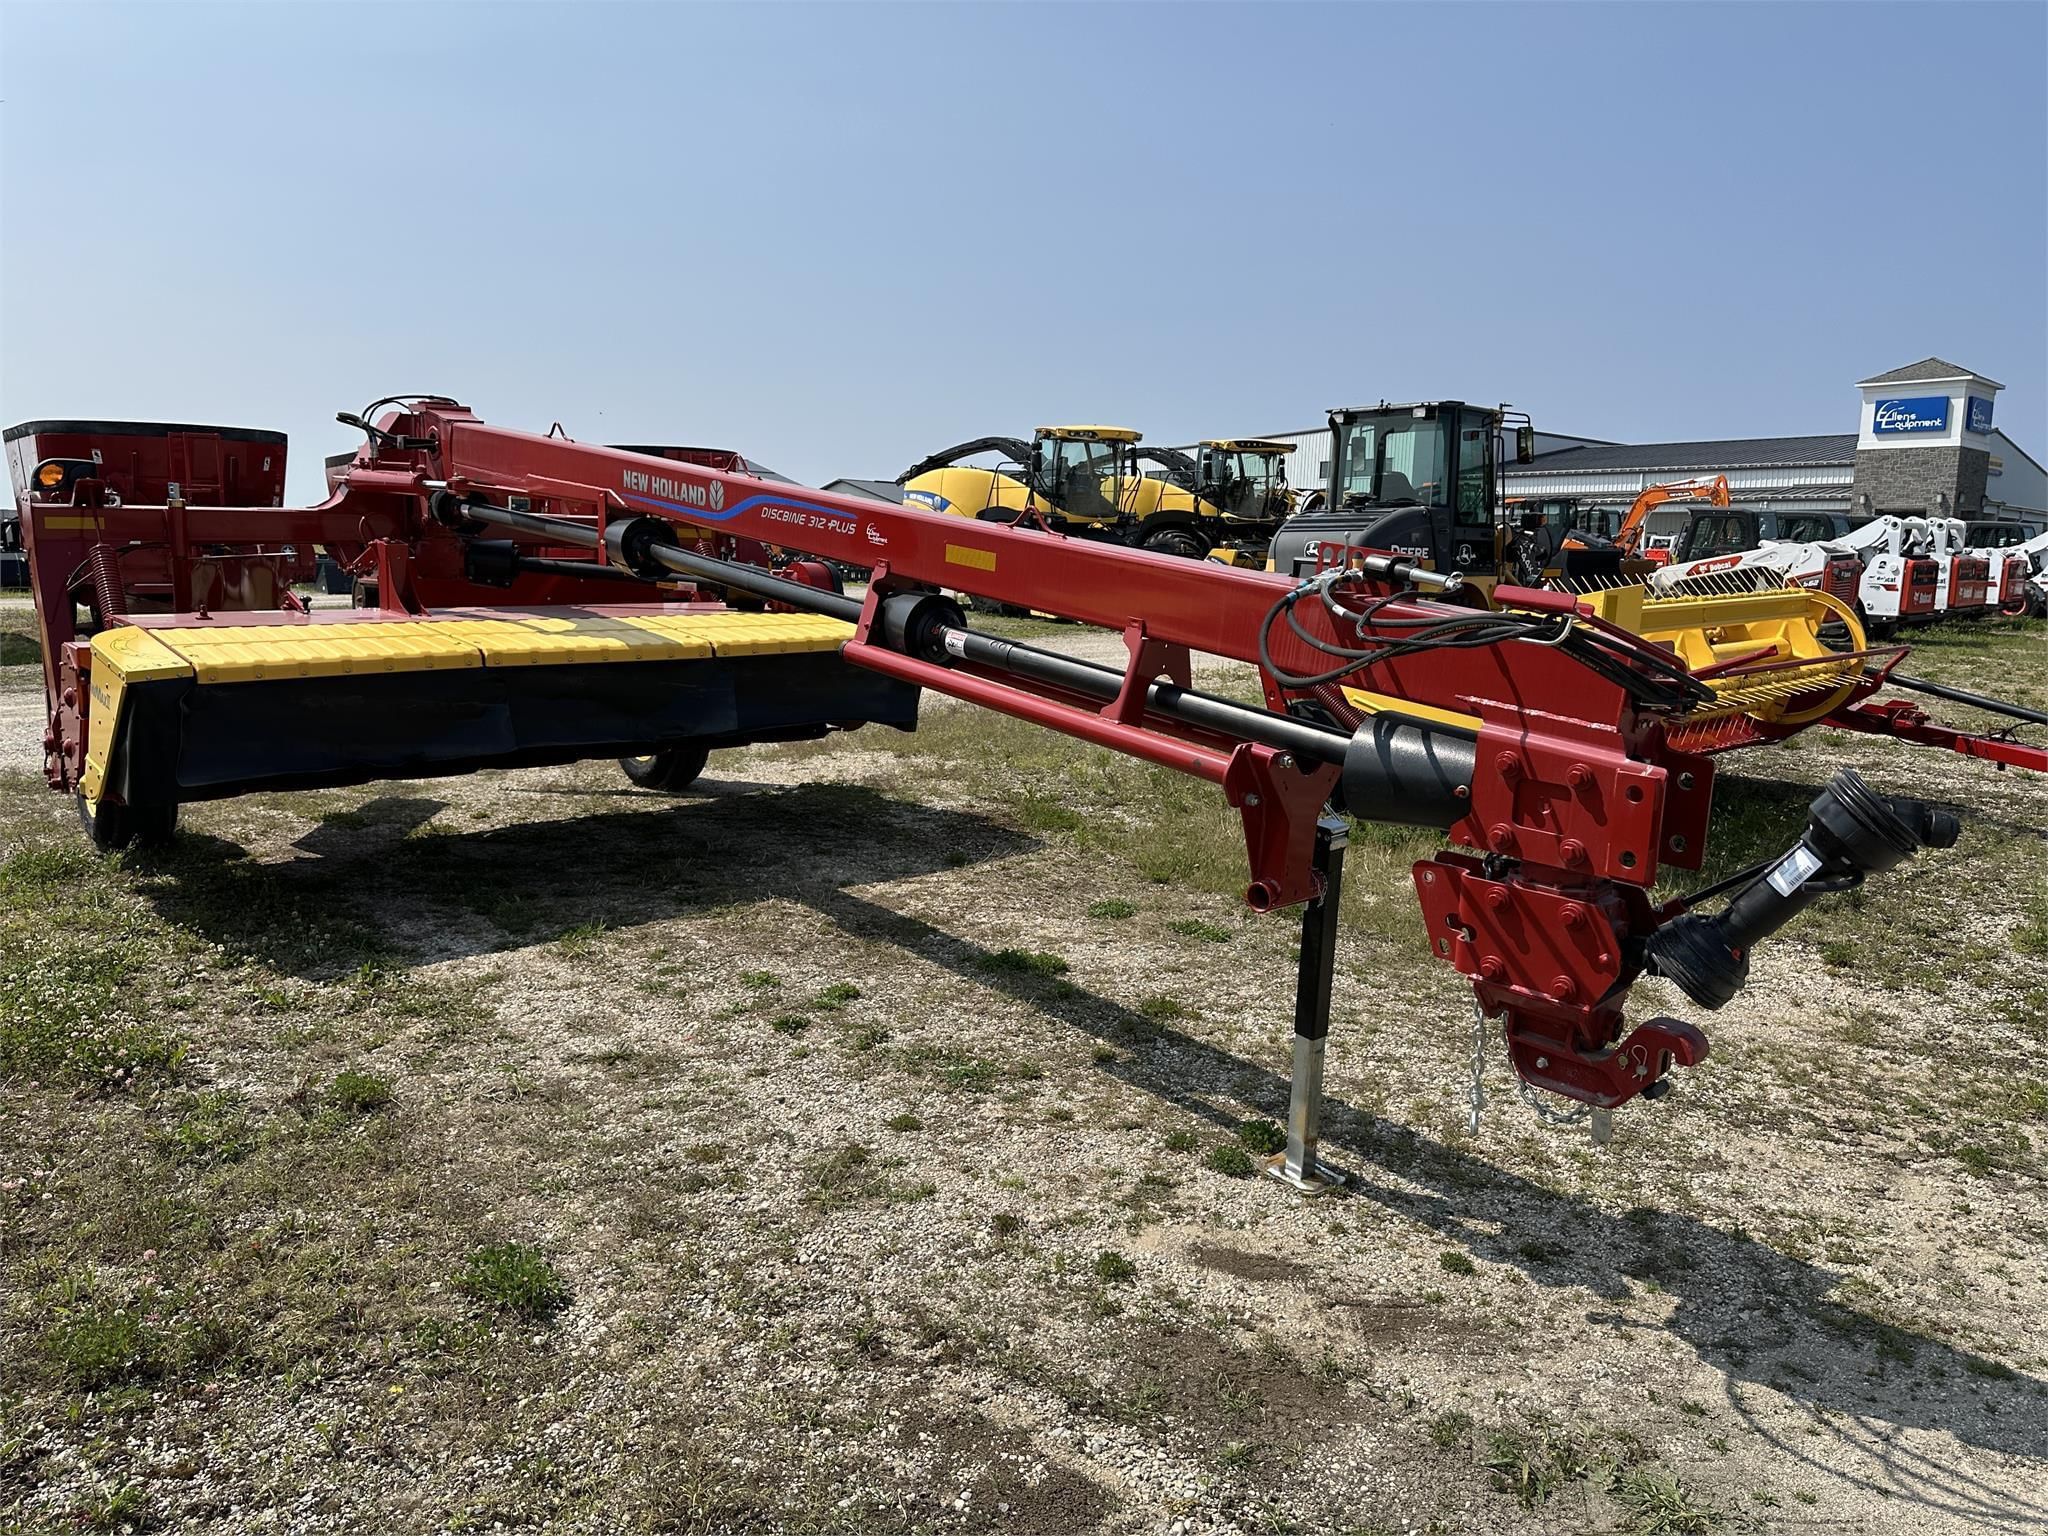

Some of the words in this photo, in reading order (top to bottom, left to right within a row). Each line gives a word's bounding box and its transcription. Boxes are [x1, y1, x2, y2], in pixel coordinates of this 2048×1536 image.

[1882, 411, 1942, 430] Equipment
[623, 469, 649, 493] NEW
[652, 476, 706, 507] HOLLAND
[761, 506, 806, 525] DISCBINE
[808, 515, 827, 529] 312
[1709, 561, 1731, 572] Bobcat
